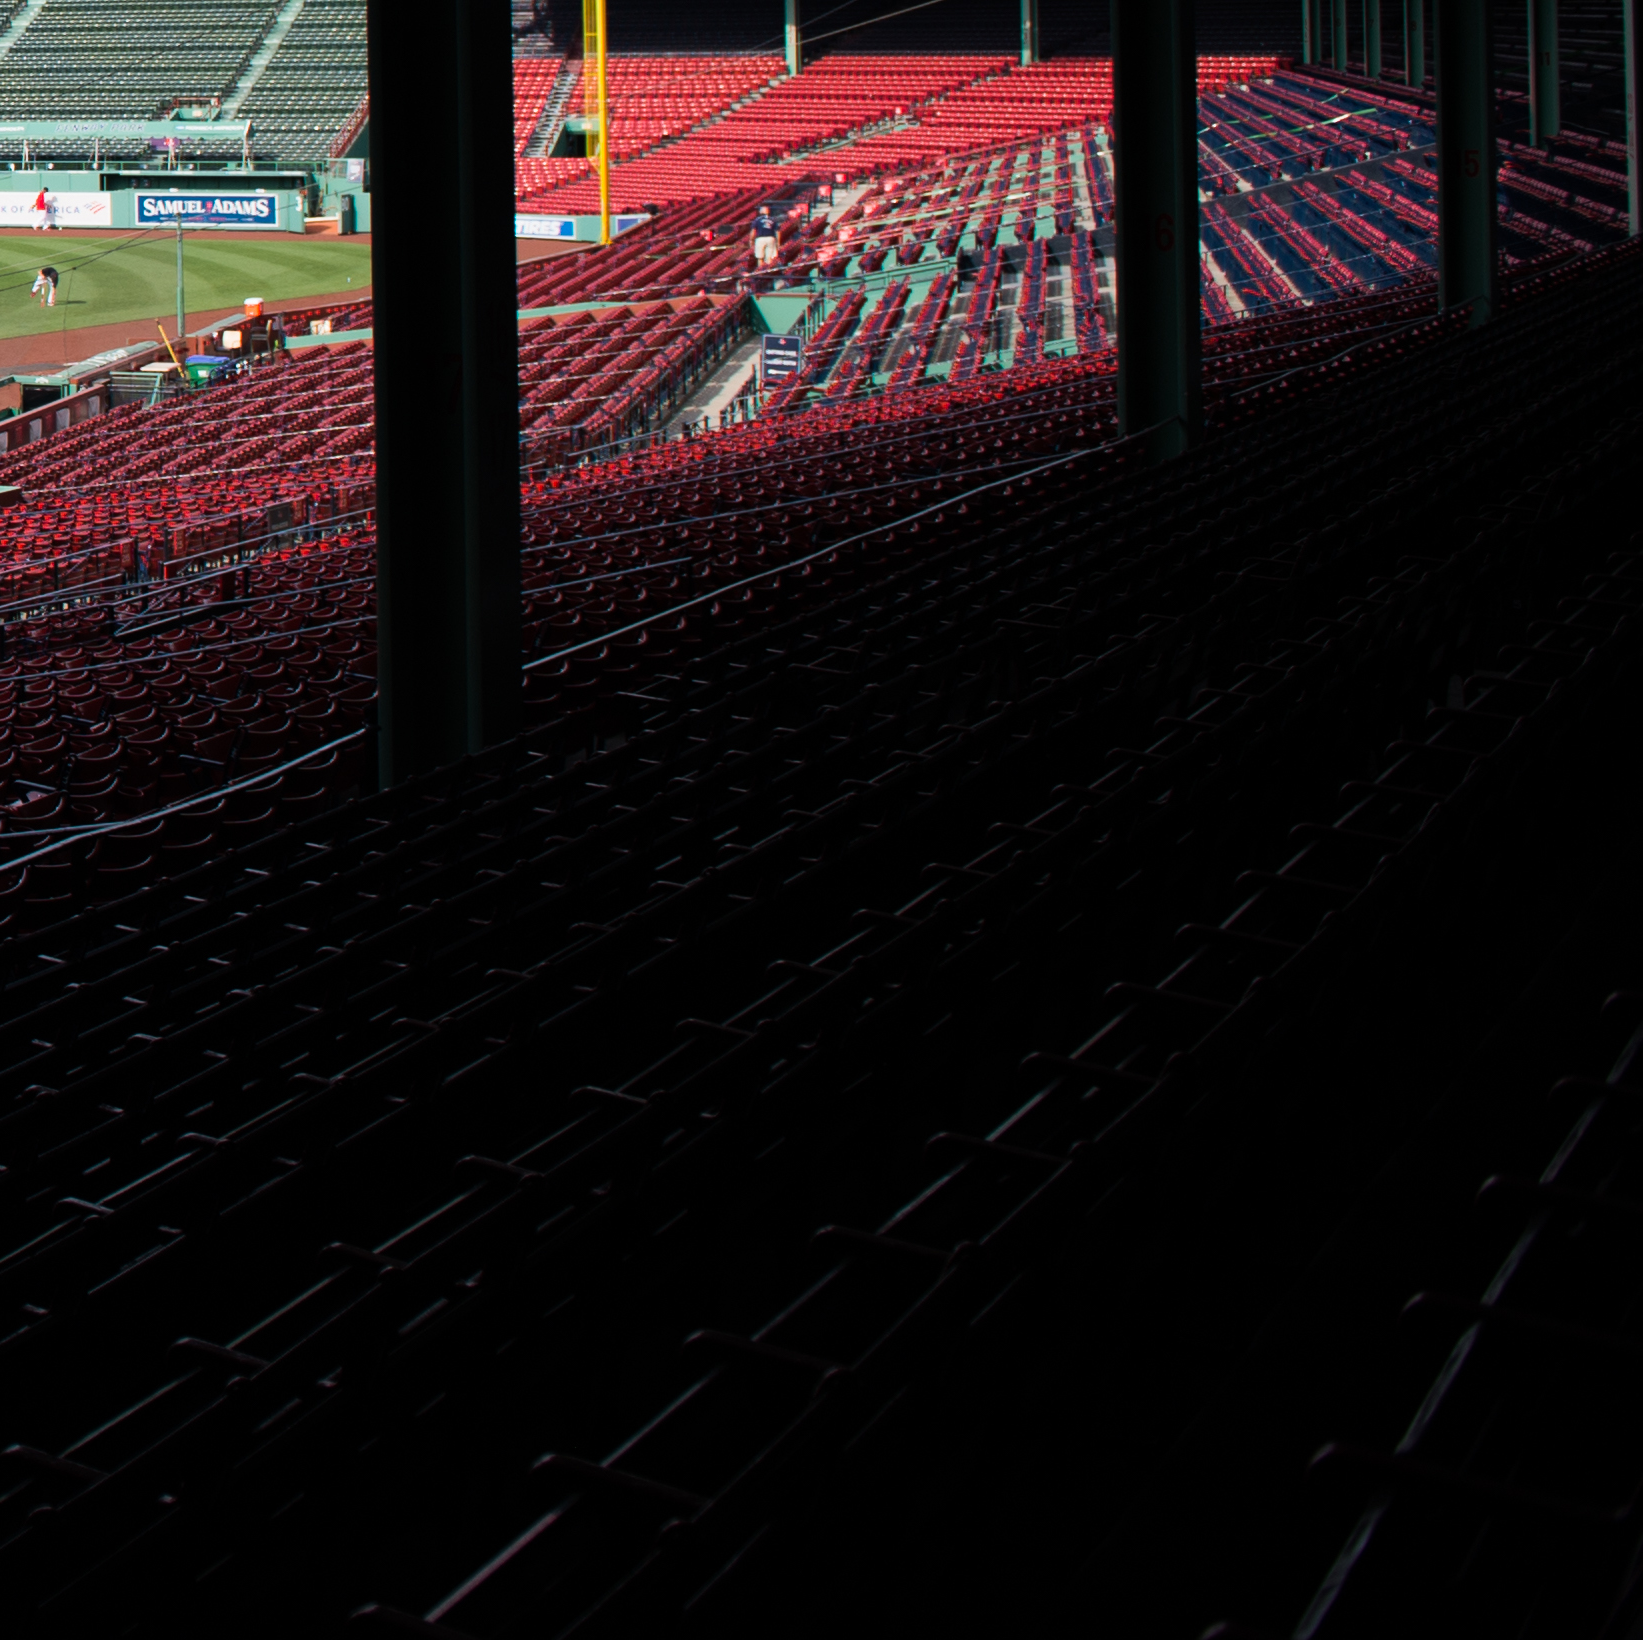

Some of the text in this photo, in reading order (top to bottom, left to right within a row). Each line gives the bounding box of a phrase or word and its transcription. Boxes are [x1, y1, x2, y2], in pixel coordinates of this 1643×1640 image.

[10, 205, 25, 213] OF
[143, 198, 270, 217] SAMUEL ADAMS
[516, 221, 562, 235] TIRES
